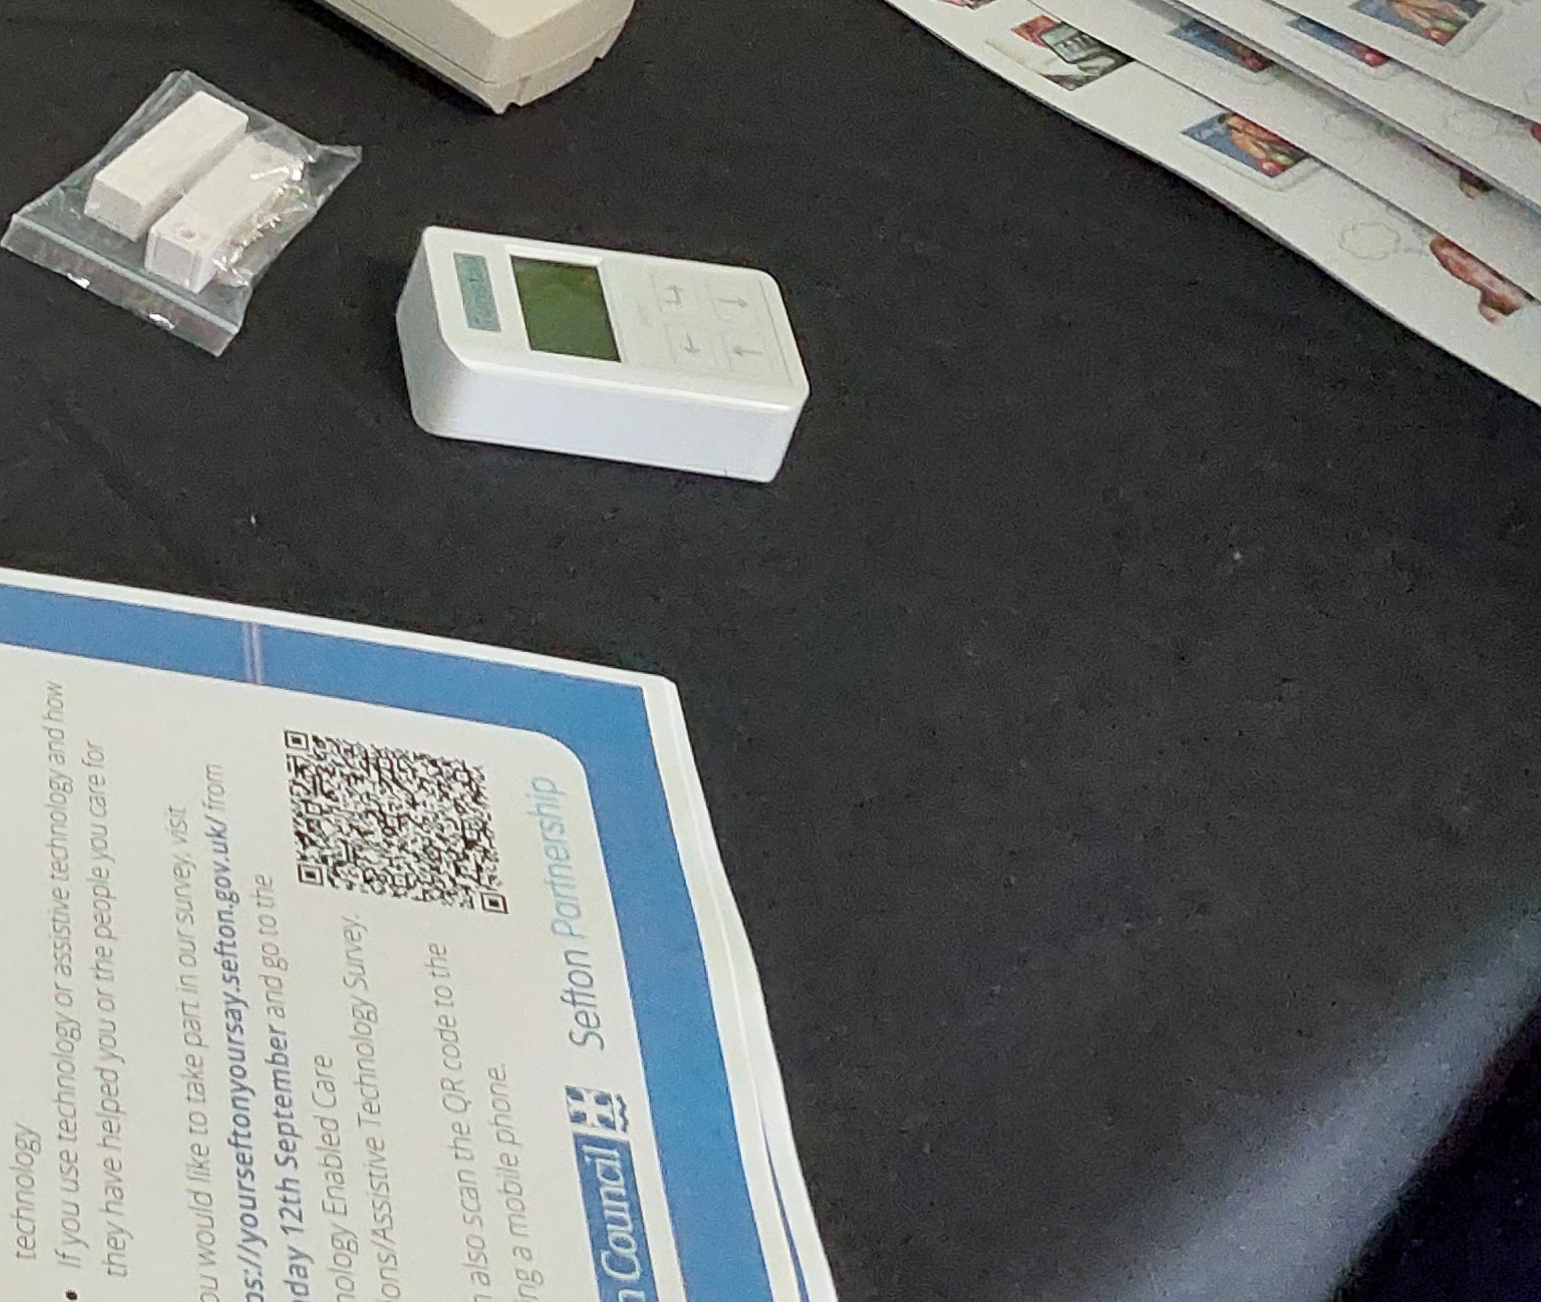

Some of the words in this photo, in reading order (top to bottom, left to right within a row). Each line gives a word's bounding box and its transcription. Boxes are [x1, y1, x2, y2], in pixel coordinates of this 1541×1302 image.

[201, 764, 225, 810] from
[250, 873, 275, 908] the
[525, 776, 585, 939] Partnership
[257, 913, 278, 936] to
[260, 941, 288, 971] go
[340, 914, 369, 992] Survey.
[257, 973, 285, 1019] and
[558, 948, 605, 1051] Sefton
[203, 813, 268, 1301] ps://yourseftonyoursay.sefton.gov.uk/
[263, 1022, 303, 1171] September
[310, 1053, 337, 1109] Care
[348, 993, 381, 1130] Technology
[311, 1113, 348, 1217] Enabled
[273, 1176, 304, 1236] 12th
[361, 1135, 402, 1299] ons/Assistive
[581, 1144, 642, 1281] Council
[281, 1243, 315, 1298] day
[325, 1221, 359, 1301] nology
